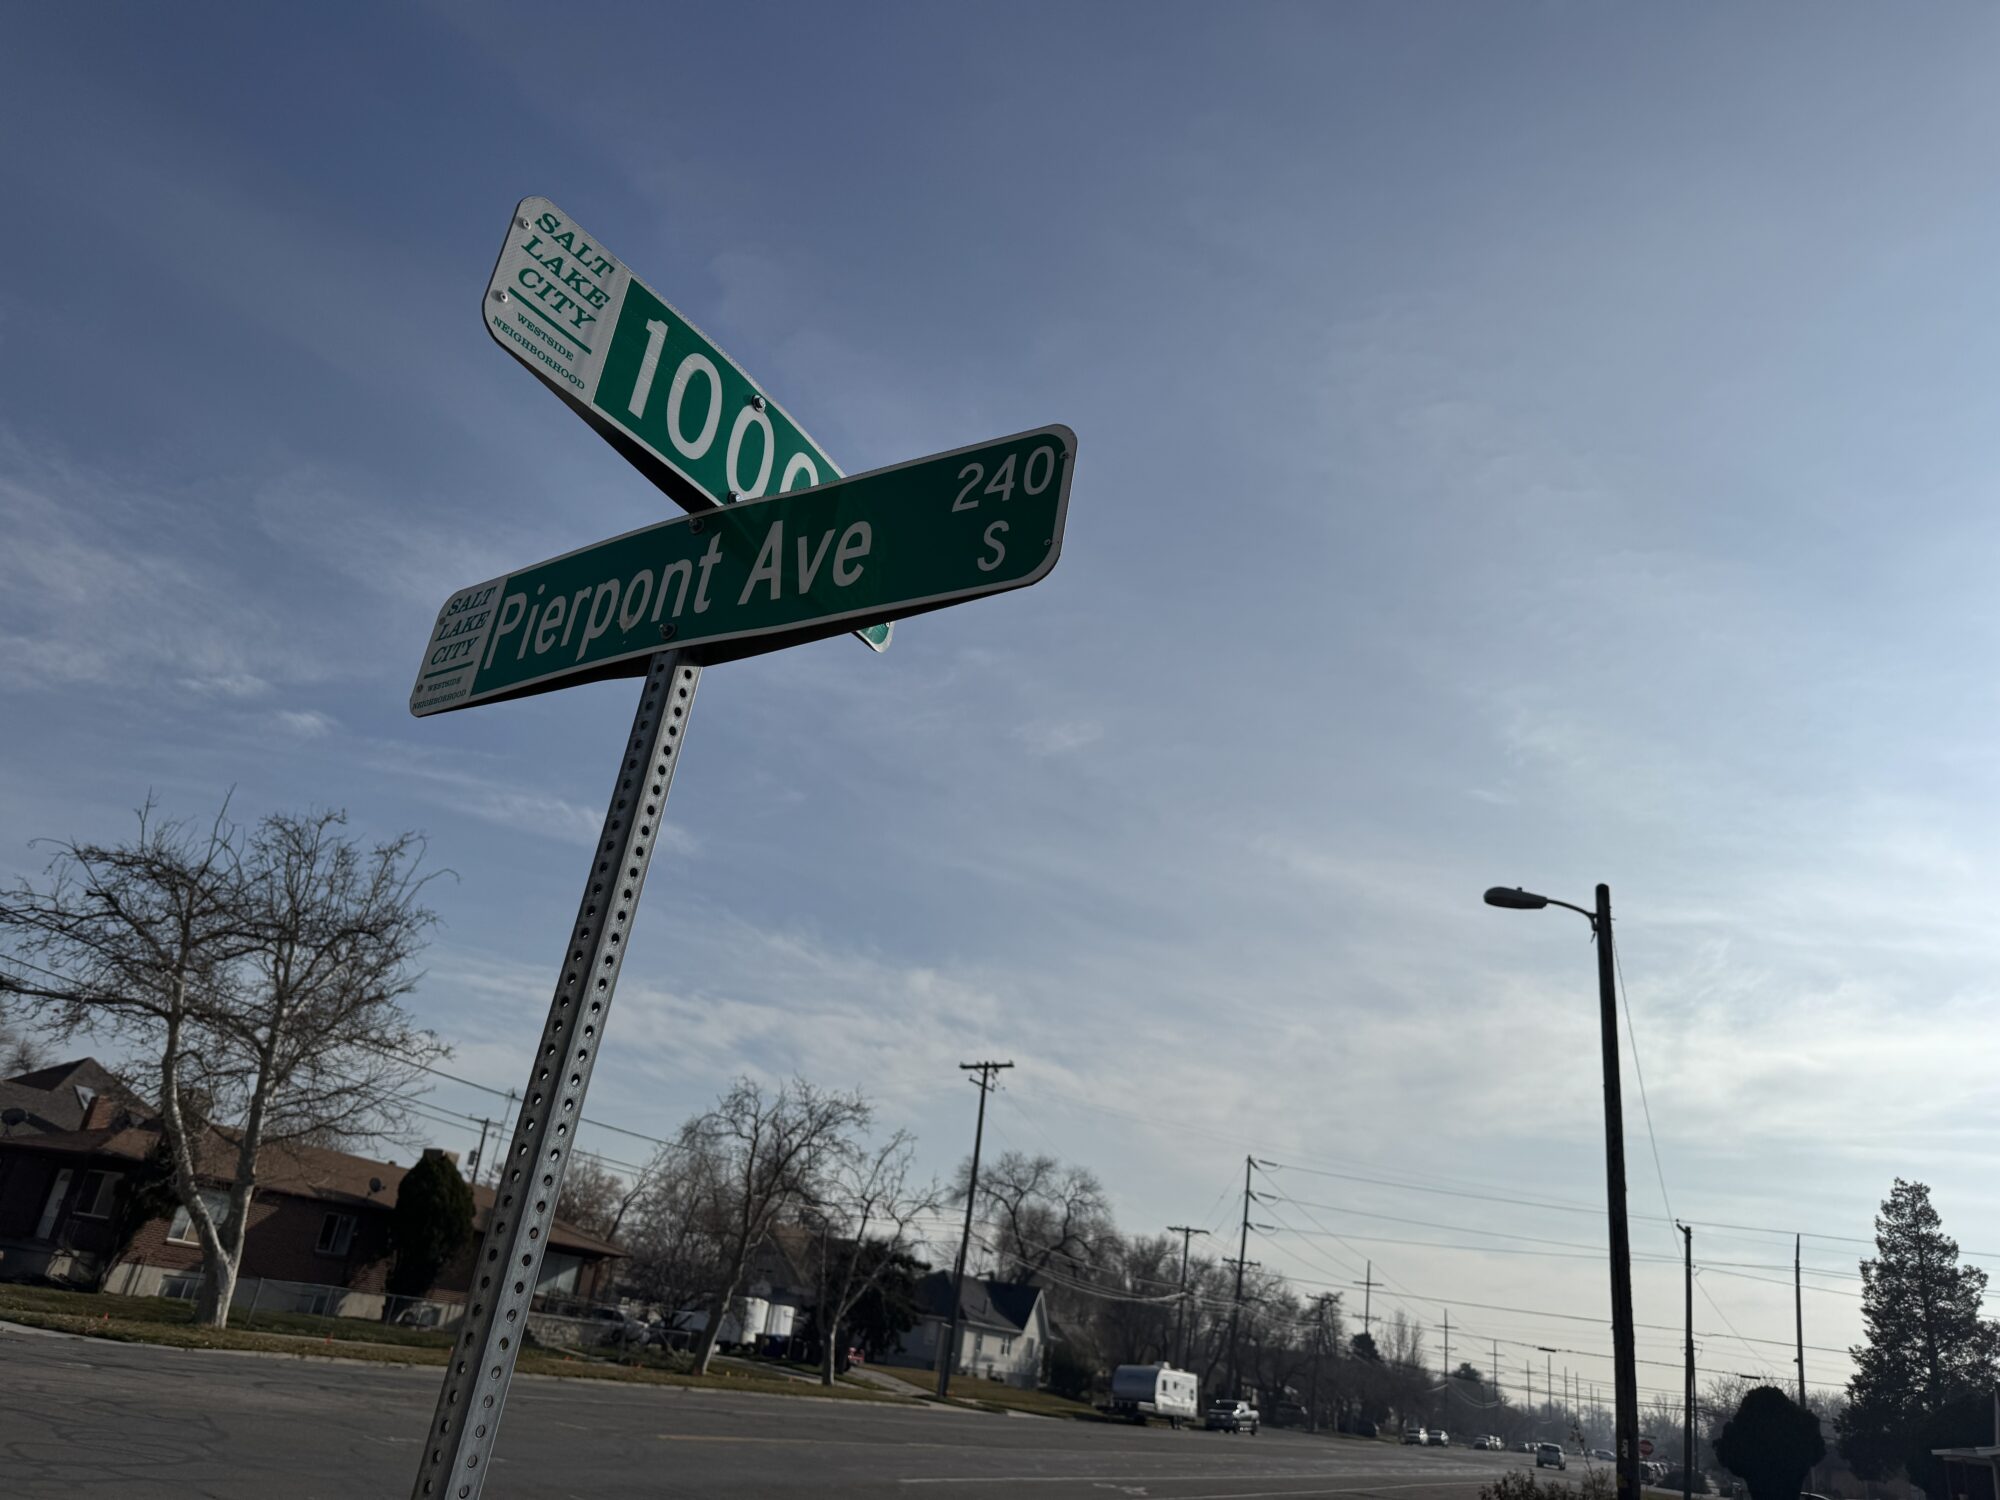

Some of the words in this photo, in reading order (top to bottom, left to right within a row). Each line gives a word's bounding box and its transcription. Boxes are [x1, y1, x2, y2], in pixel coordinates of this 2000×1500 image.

[521, 235, 611, 310] LAKE
[535, 212, 615, 278] SALT
[518, 268, 597, 329] CITY
[492, 316, 585, 390] NEIGHBORHOOD
[517, 312, 574, 361] WESTSIDE
[951, 445, 1055, 512] 240
[977, 520, 1010, 572] S
[435, 610, 491, 641] LAKE
[447, 586, 497, 616] SALT
[483, 532, 723, 670] Pierpont
[737, 520, 872, 606] Ave
[431, 636, 479, 665] CITY
